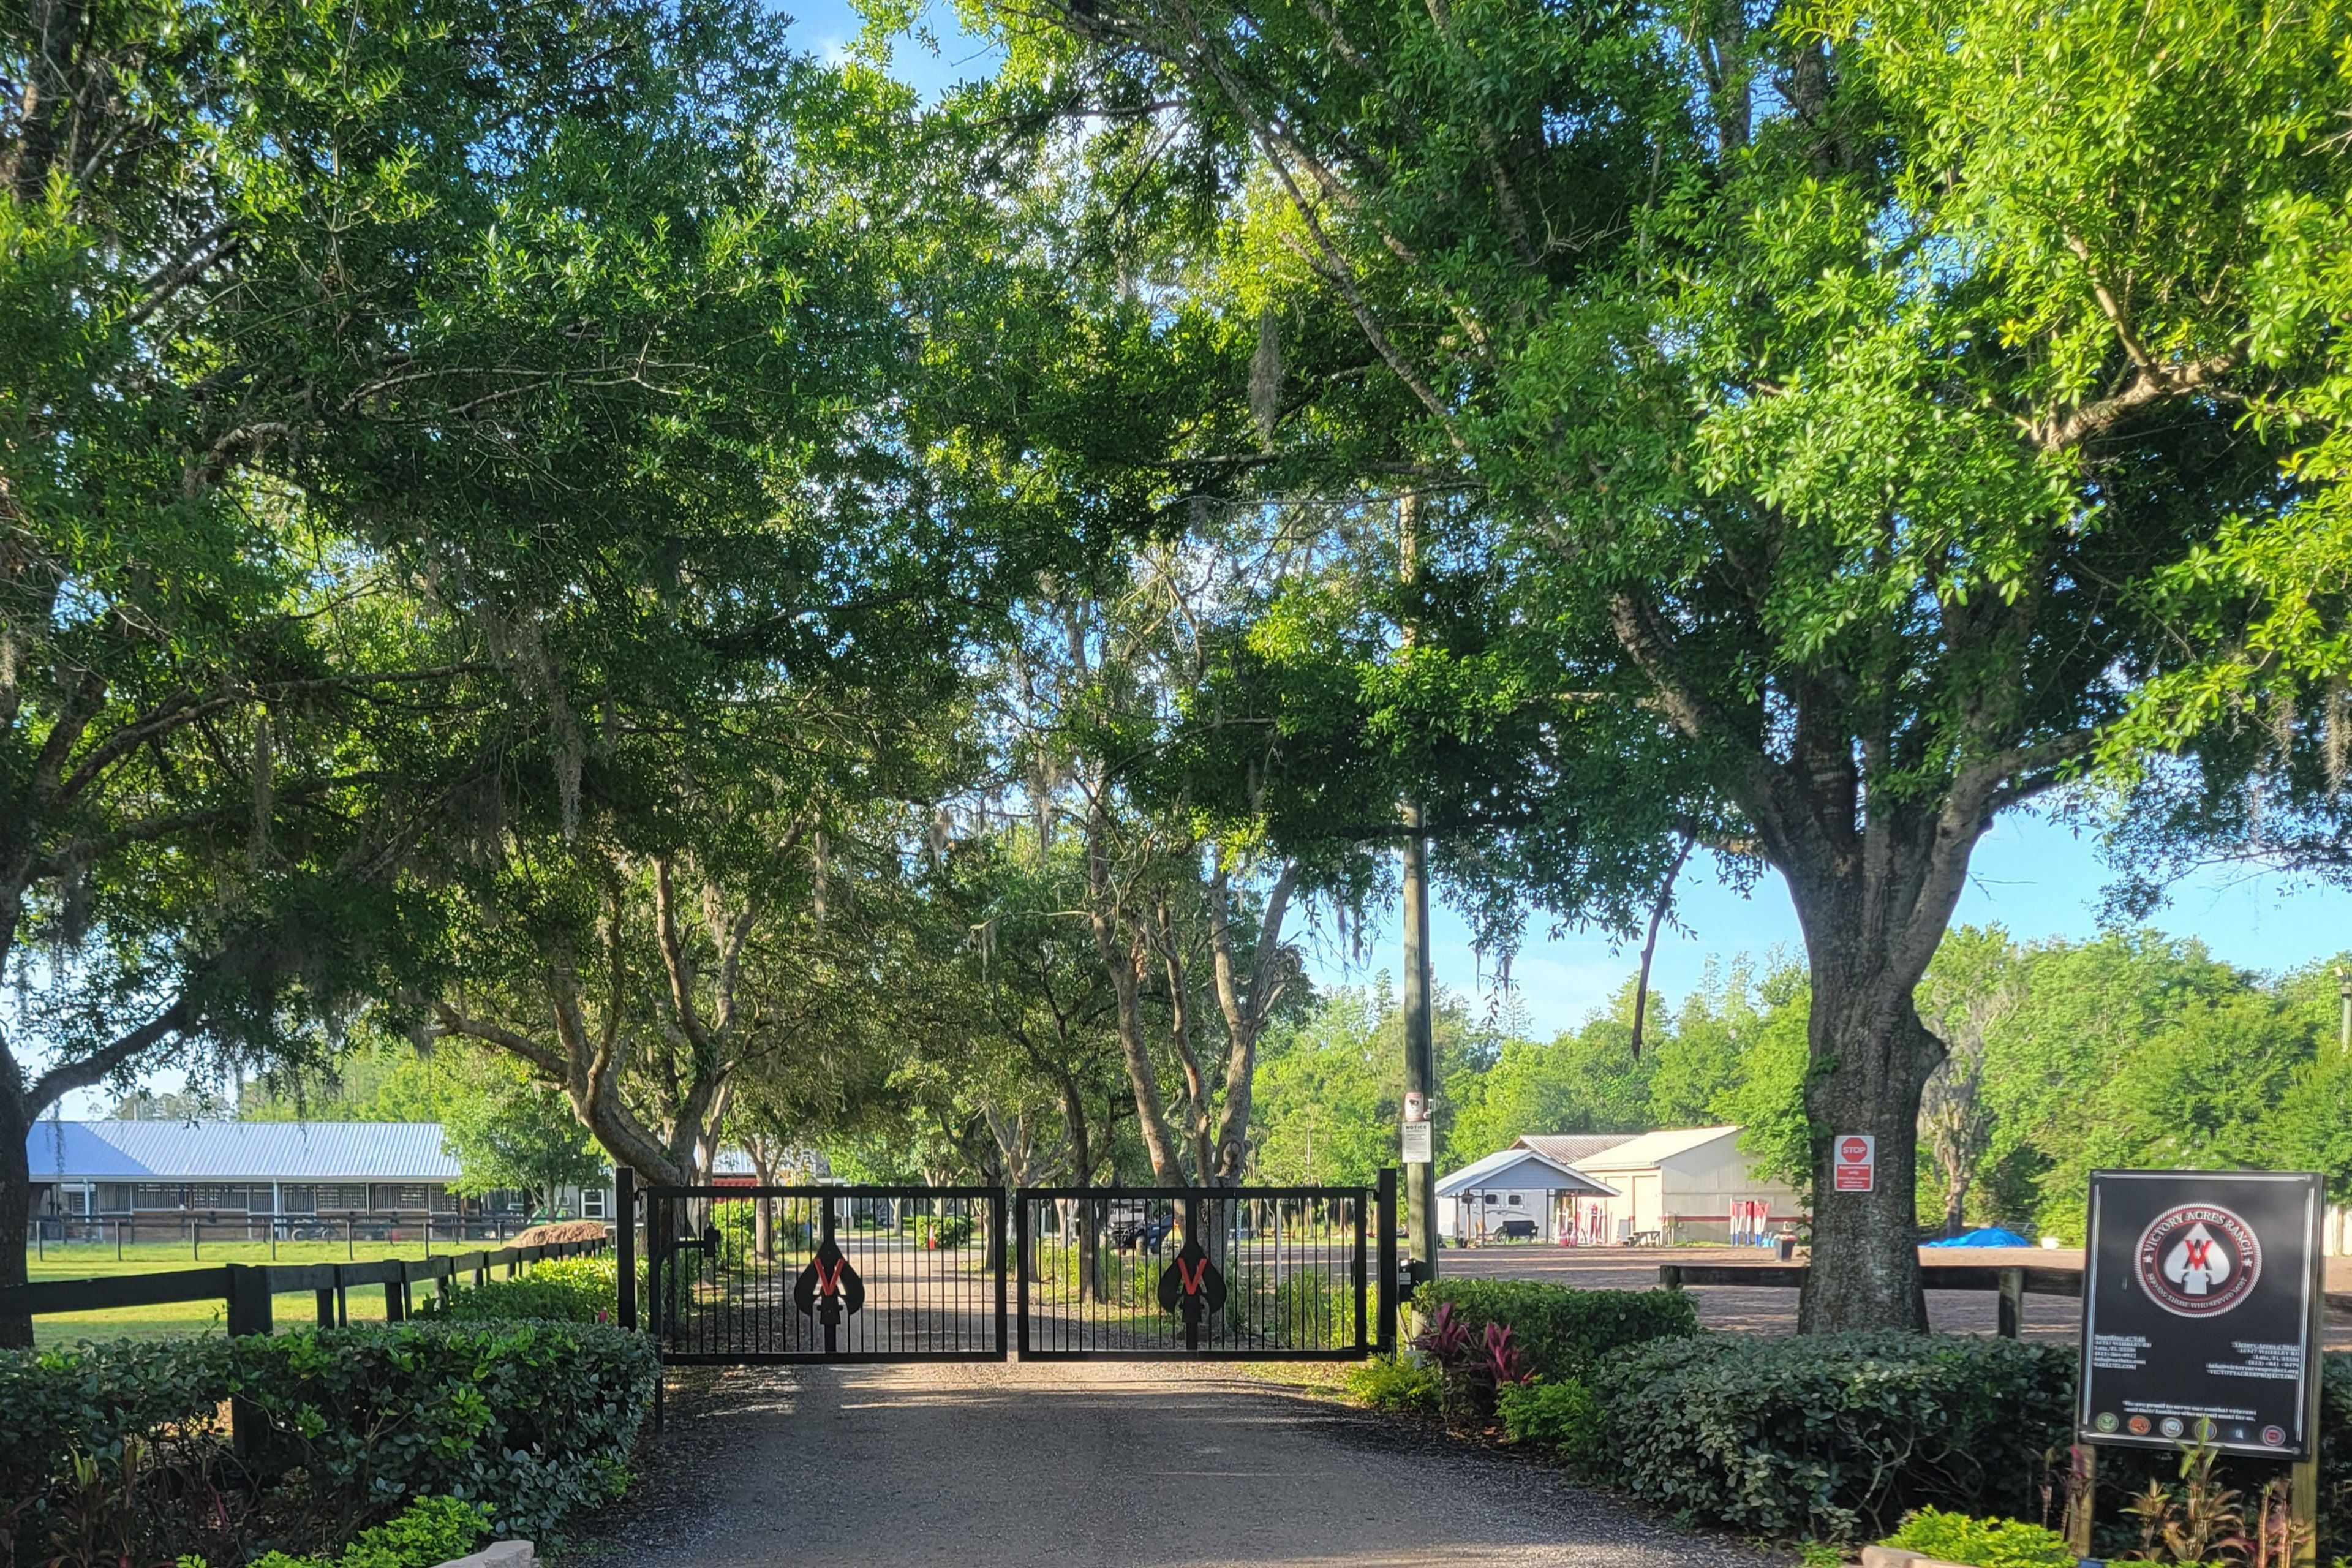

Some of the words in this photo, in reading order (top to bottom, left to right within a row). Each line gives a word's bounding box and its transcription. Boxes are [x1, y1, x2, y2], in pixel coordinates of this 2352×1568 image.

[2145, 1212, 2184, 1252] VICTORY
[2185, 1211, 2226, 1224] ACRES
[2225, 1220, 2253, 1256] RANCH
[2147, 1273, 2169, 1298] SERVING
[2167, 1294, 2191, 1307] THOSE
[2209, 1292, 2235, 1307] SERVED
[2232, 1277, 2248, 1294] MOST
